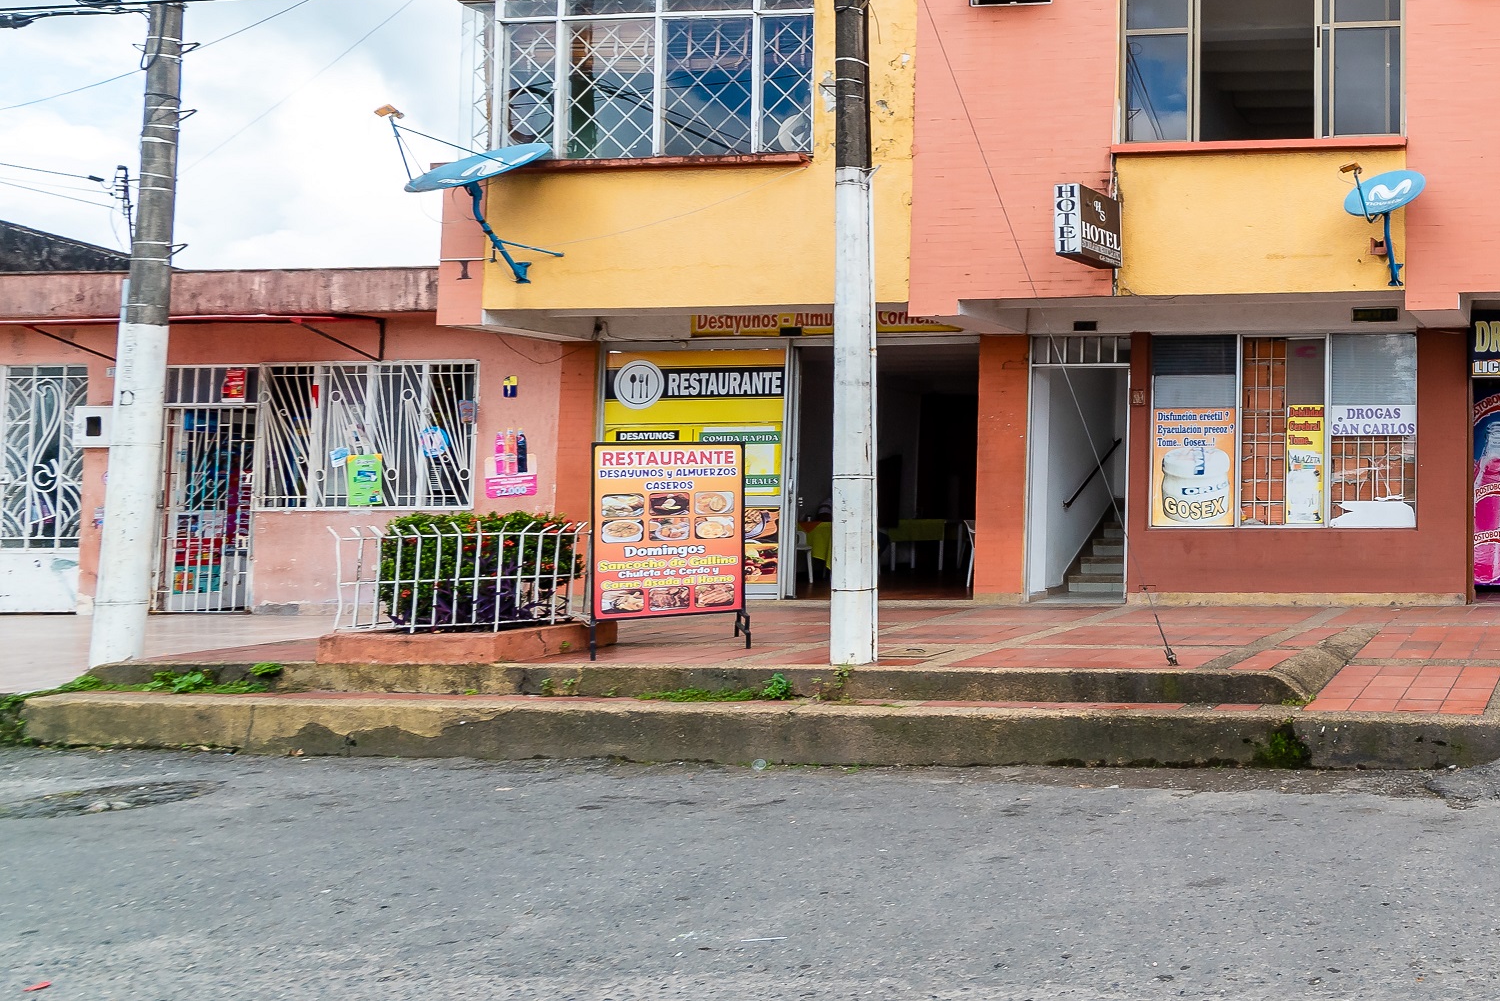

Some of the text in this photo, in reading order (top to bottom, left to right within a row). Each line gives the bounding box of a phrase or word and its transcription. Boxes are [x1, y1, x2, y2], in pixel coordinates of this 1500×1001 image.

[1056, 185, 1077, 253] HOTEL
[1081, 220, 1121, 251] HOTEL
[696, 313, 778, 334] Desayunos
[667, 371, 782, 397] RESTAURANTE
[1157, 411, 1197, 421] Disfunción
[1199, 411, 1223, 421] eréctil
[1346, 407, 1401, 420] DROGAS
[1157, 424, 1201, 436] Eyaculación
[1203, 426, 1228, 436] precoz
[1288, 420, 1321, 432] Cerebral
[1331, 423, 1415, 435] SAN CARLOS
[619, 431, 676, 441] DESAYUNOS
[702, 434, 779, 443] COMIDA RAPIDA
[601, 450, 735, 467] RESTAURANTE
[599, 469, 664, 478] DESAYUNOS
[675, 467, 737, 477] ALMUERZOS
[645, 481, 694, 490] CASEROS
[1163, 495, 1226, 521] GOSEX
[623, 544, 706, 558] Domingos
[599, 555, 738, 572] Sancocho de Gallina
[618, 567, 720, 579] Chuleta de Cerdo y
[601, 574, 735, 591] Carne Asada al Horno
